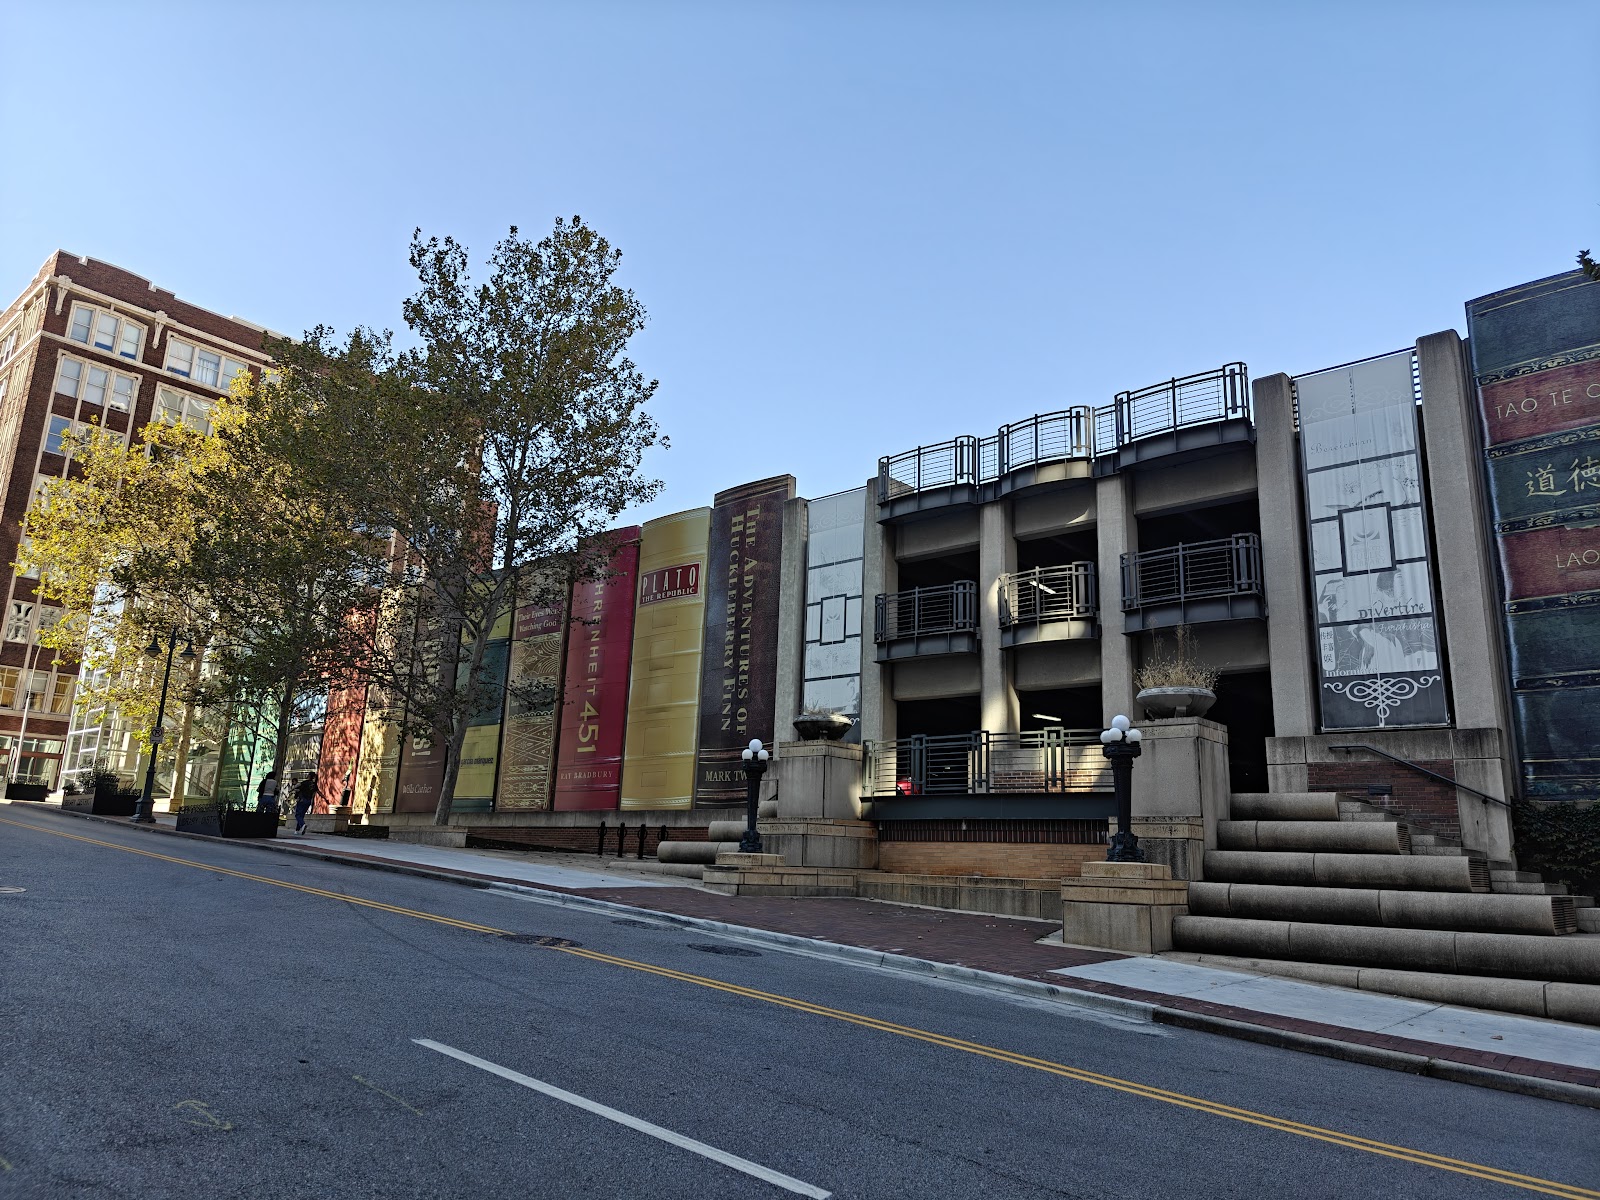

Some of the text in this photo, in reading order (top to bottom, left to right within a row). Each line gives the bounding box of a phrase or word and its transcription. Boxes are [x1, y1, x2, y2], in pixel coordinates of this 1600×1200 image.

[1495, 398, 1538, 419] TAO
[1549, 389, 1573, 406] TE
[1556, 549, 1600, 568] LAO
[642, 566, 696, 596] PLATO
[642, 587, 695, 603] THE REPUBLIC
[721, 514, 745, 731] HUCKLEBERRY FINN
[736, 504, 760, 736] THE ADVENTURES OF
[577, 555, 607, 753] HRENHEIT 451
[574, 770, 613, 779] BRADBURY
[705, 770, 731, 782] MARK
